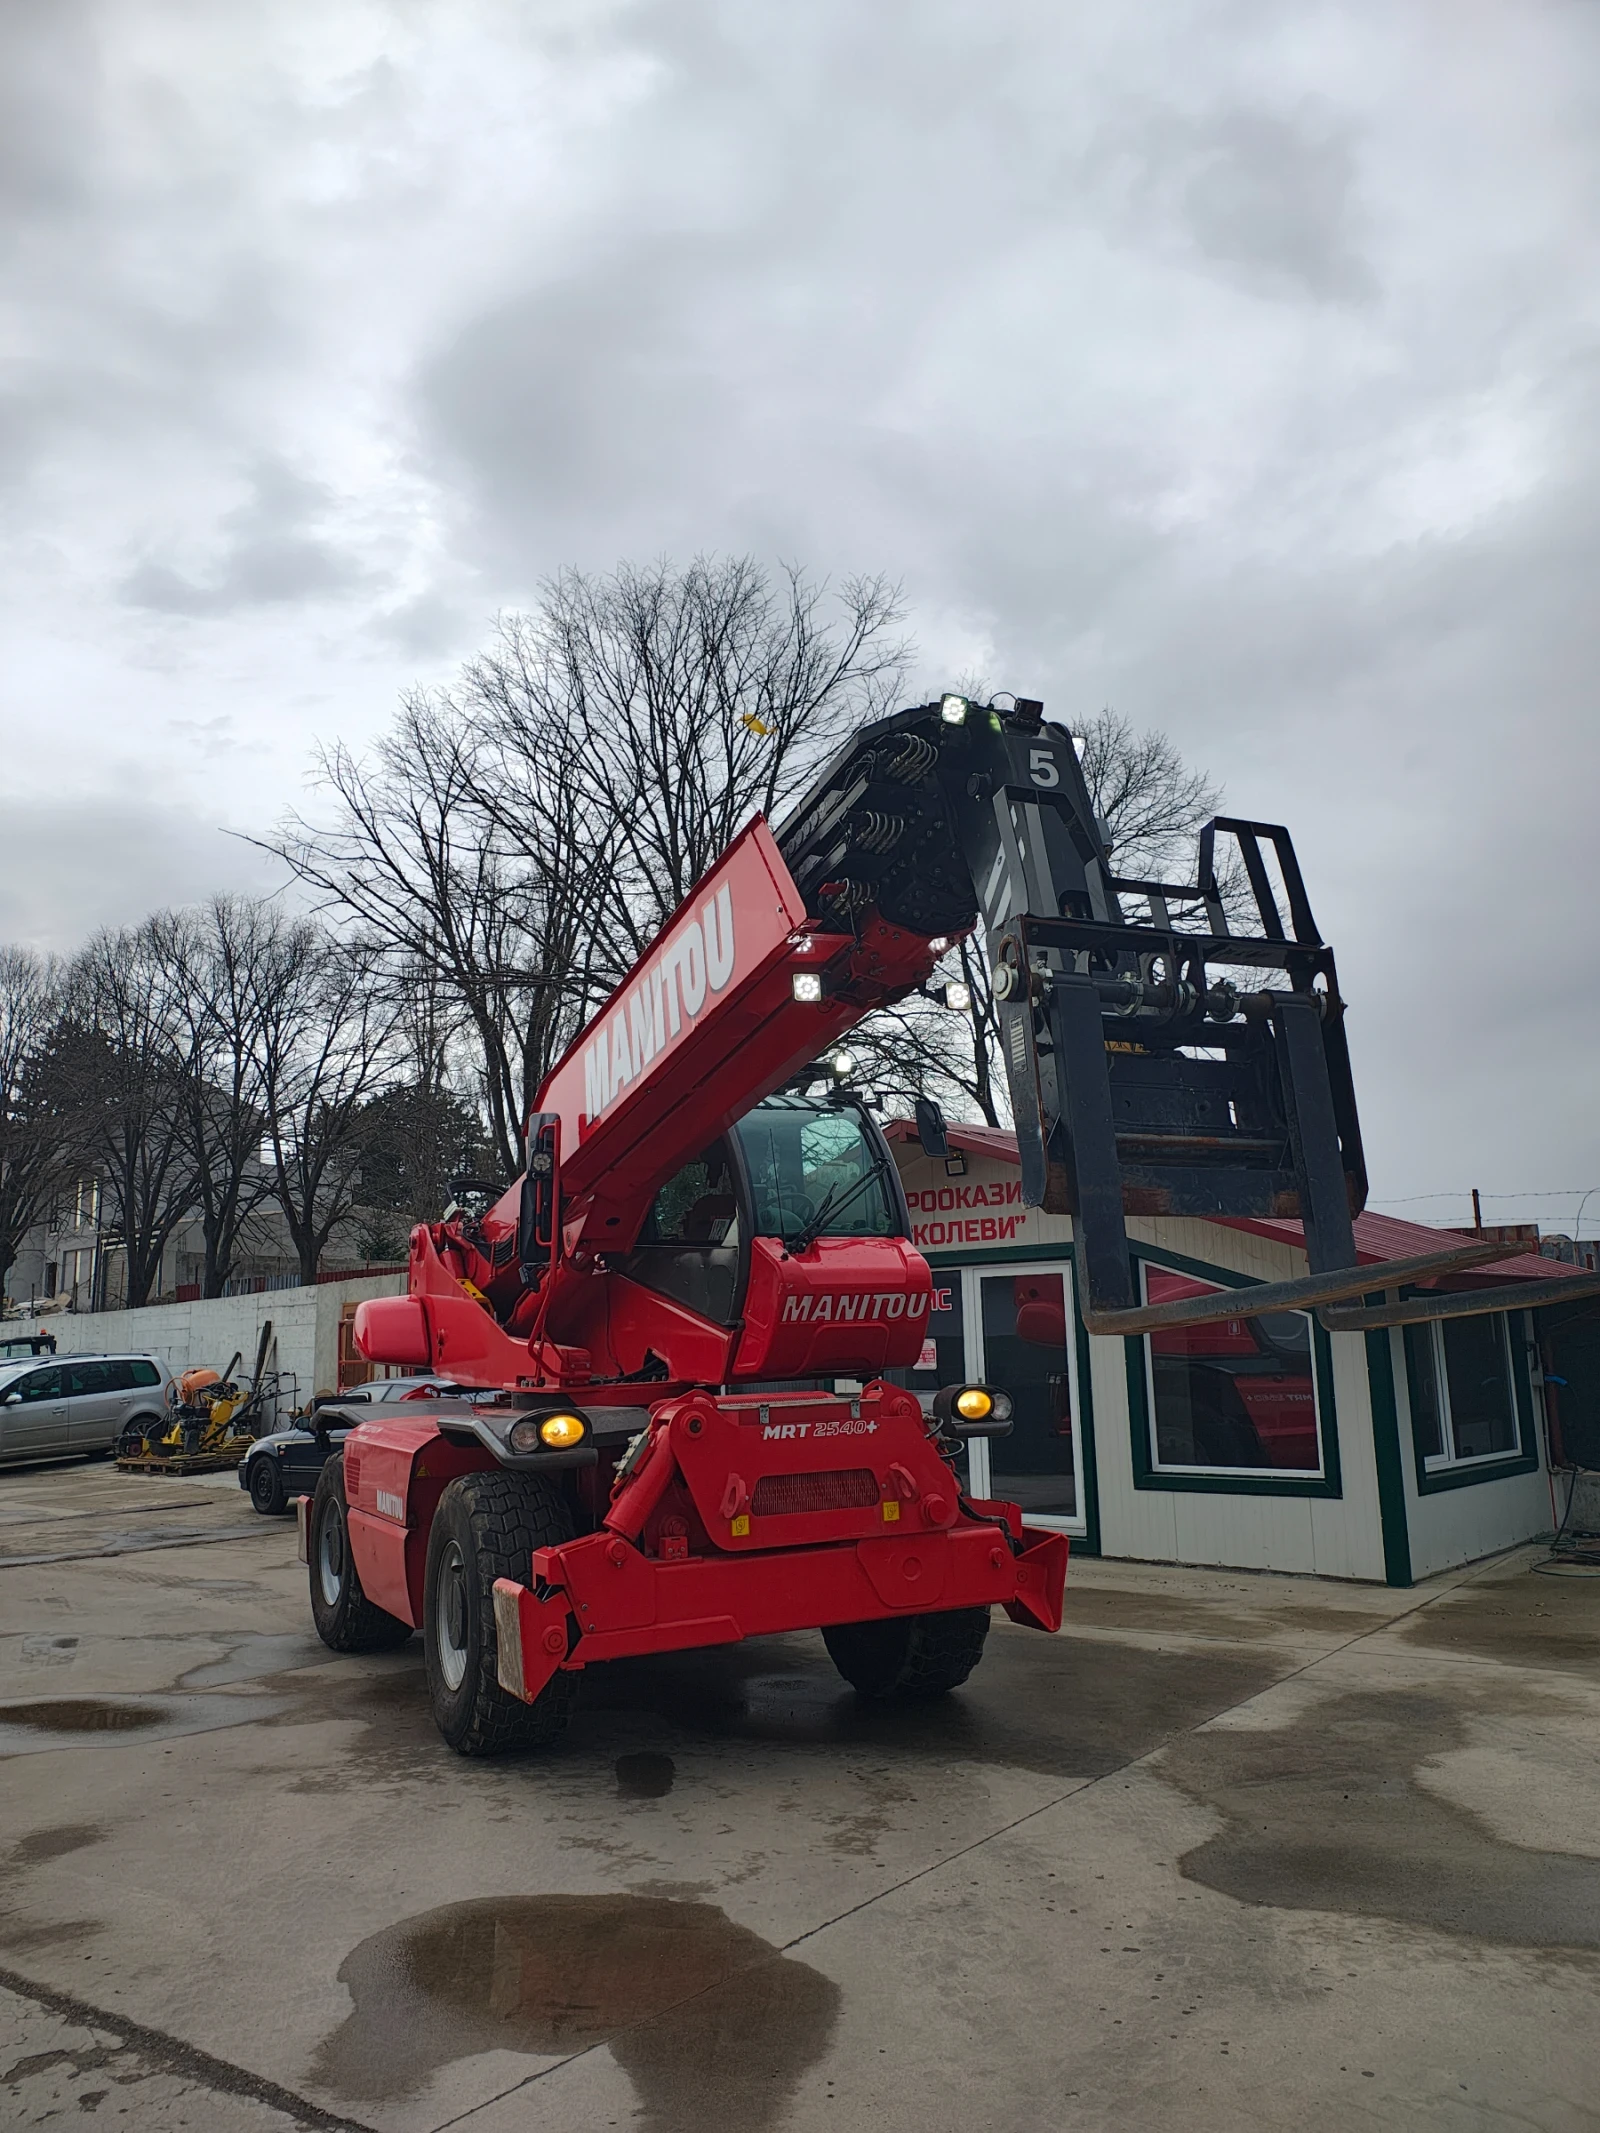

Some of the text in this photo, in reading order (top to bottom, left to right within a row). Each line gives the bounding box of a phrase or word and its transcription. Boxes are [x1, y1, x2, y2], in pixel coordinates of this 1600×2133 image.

[1030, 749, 1059, 787] 5
[584, 879, 735, 1128] MANITOU
[782, 1293, 928, 1322] MANITOU
[763, 1420, 877, 1440] MRT 2540+
